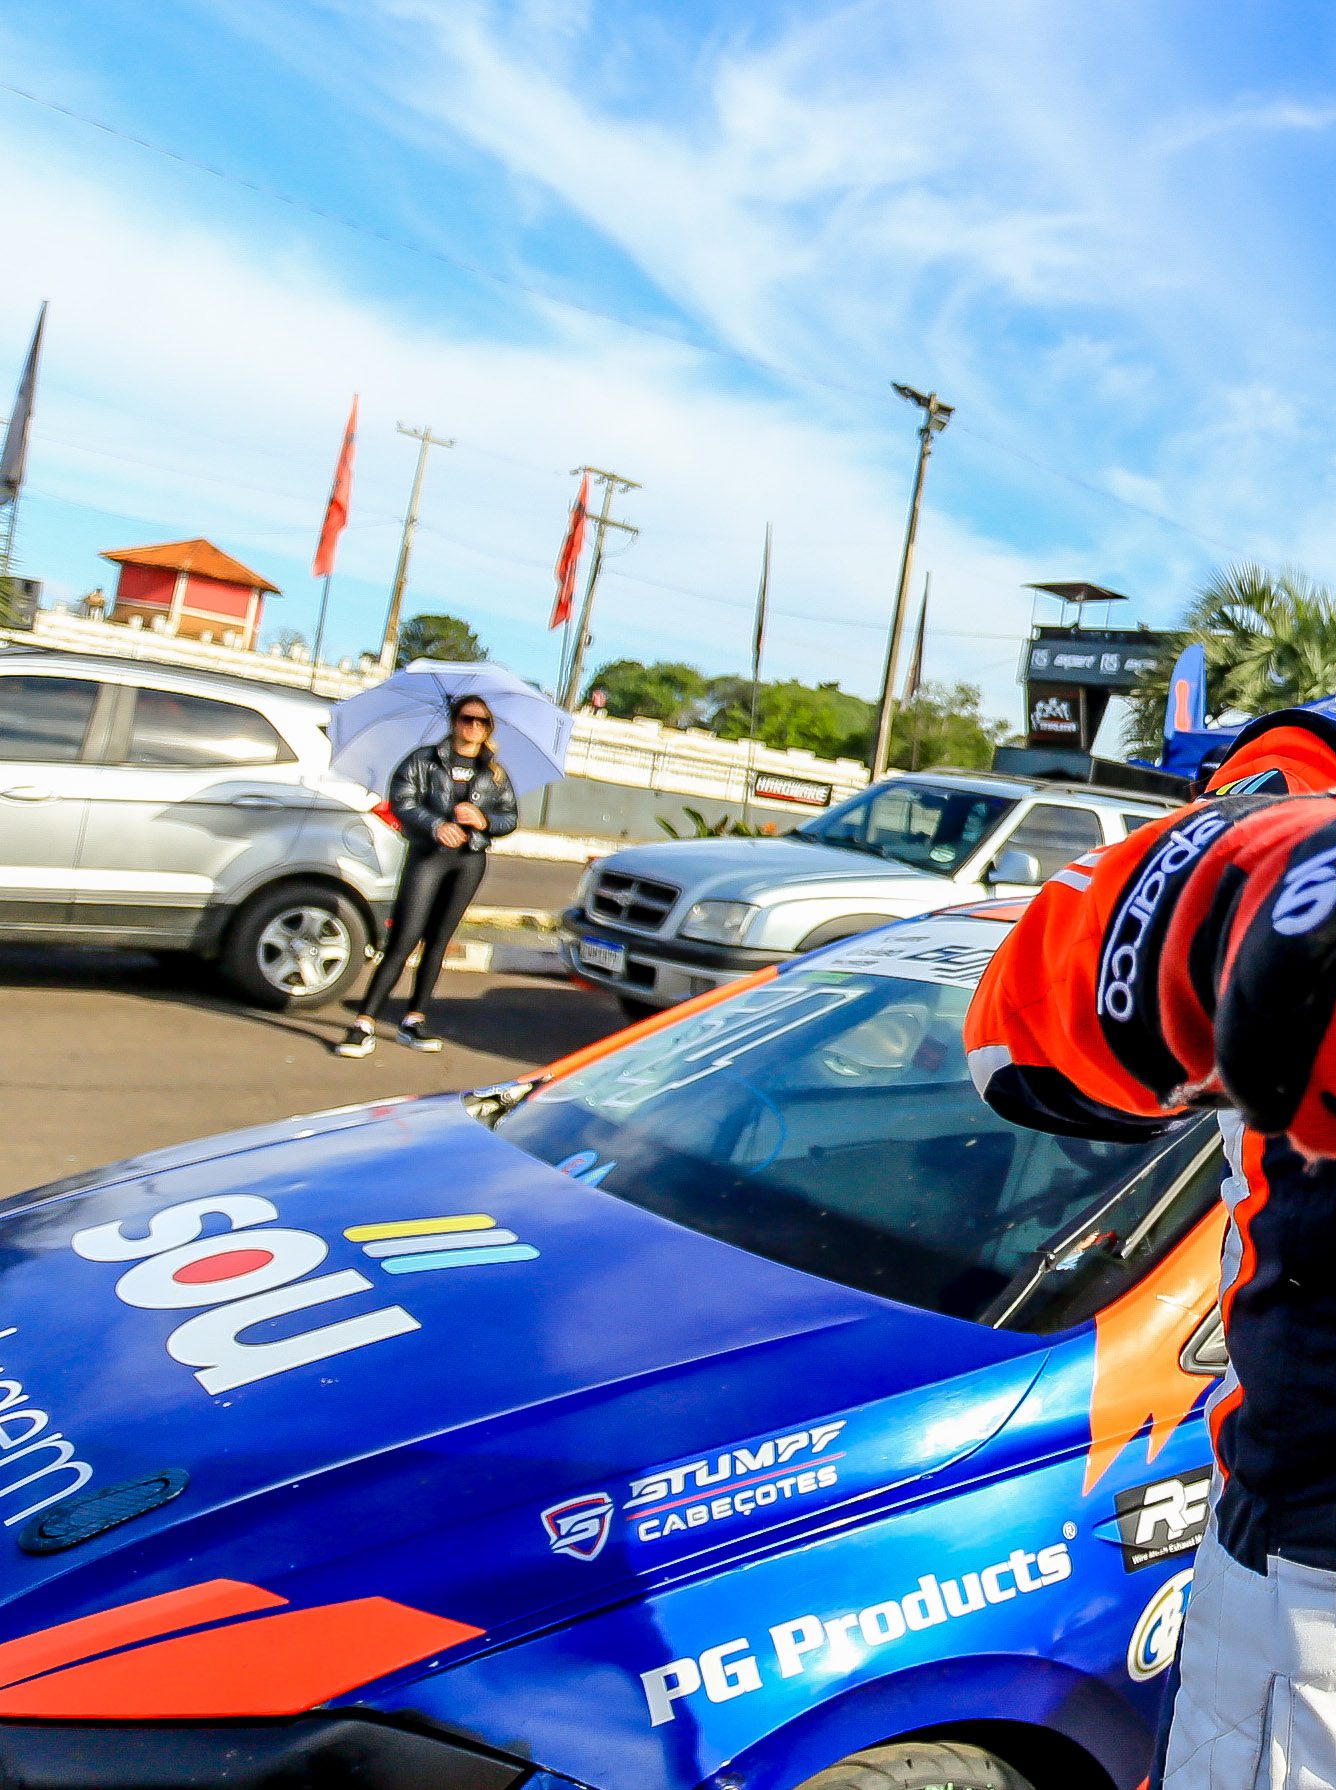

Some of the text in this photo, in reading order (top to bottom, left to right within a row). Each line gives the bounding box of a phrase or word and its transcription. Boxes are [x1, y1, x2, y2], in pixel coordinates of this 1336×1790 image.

[1098, 810, 1227, 1023] sparco
[70, 1193, 422, 1396] sou
[621, 1419, 848, 1510] STUMPF
[637, 1464, 839, 1542] CABEÇOTES
[641, 1636, 764, 1728] PG
